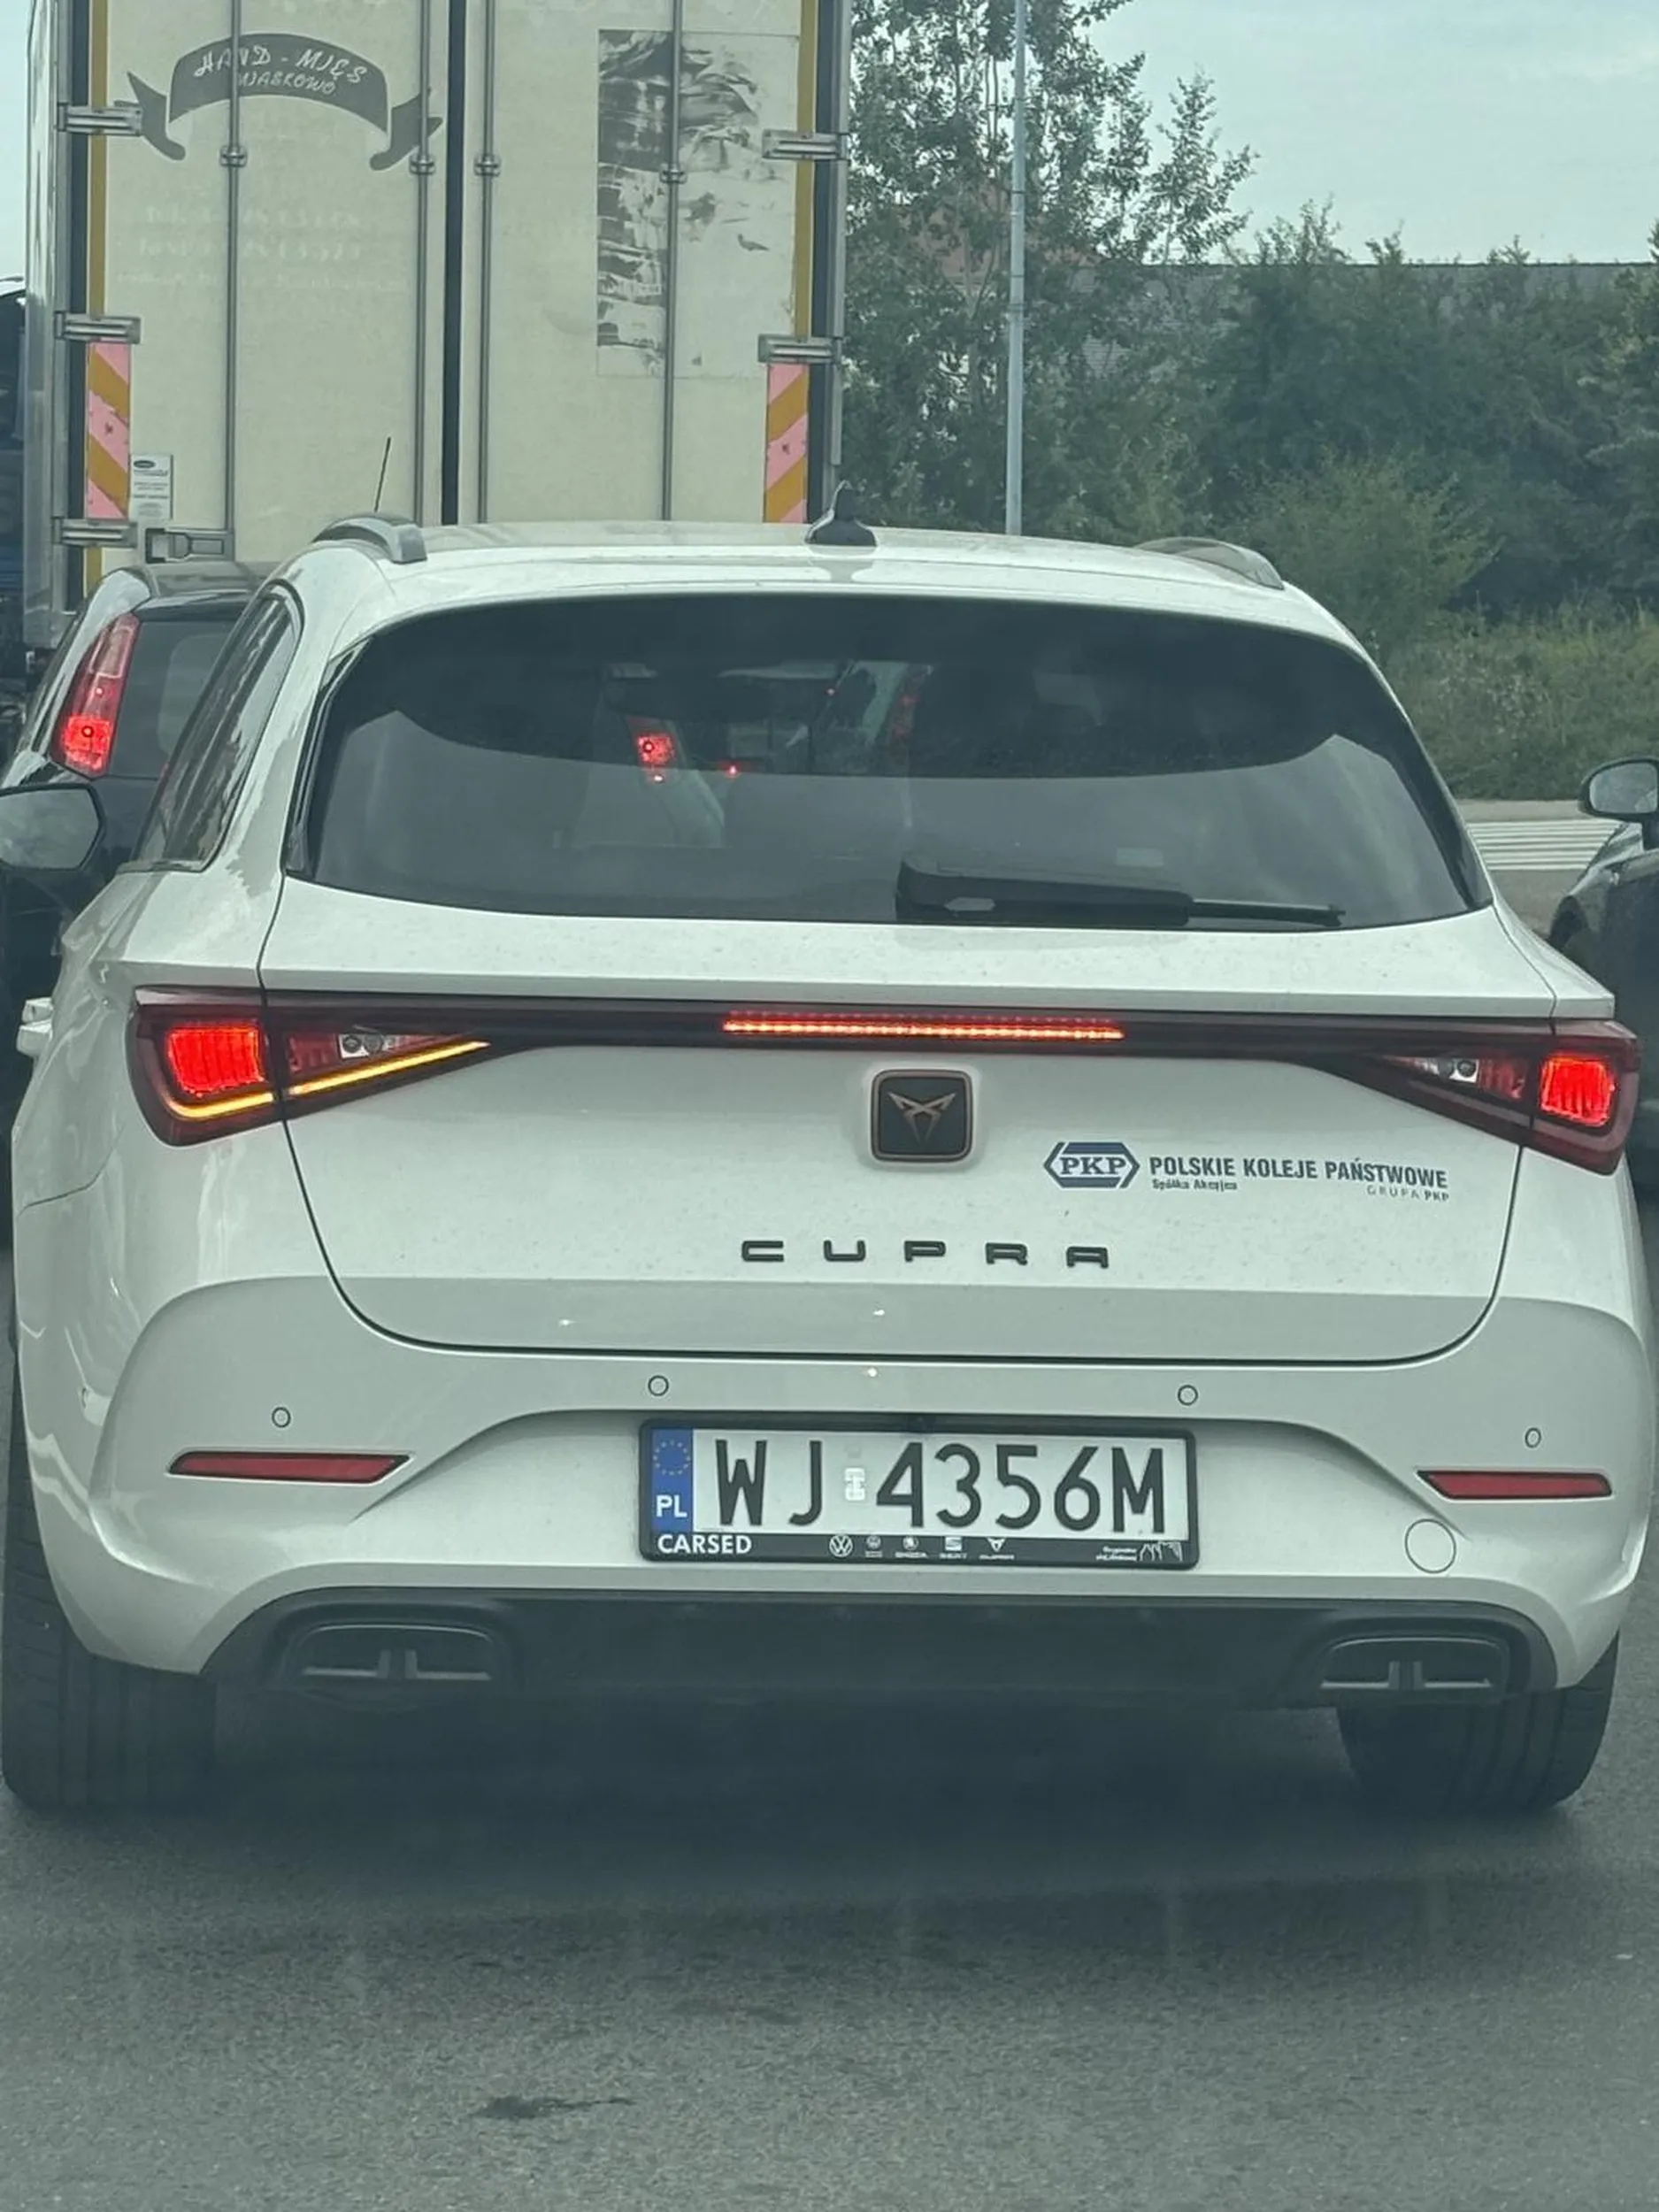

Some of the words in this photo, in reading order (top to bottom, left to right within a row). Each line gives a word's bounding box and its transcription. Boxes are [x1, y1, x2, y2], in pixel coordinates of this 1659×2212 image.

[1059, 1156, 1127, 1175] PKP
[1149, 1156, 1236, 1177] POLSKIE
[1242, 1157, 1318, 1179] KOLEJE
[1325, 1156, 1448, 1189] PAŃSTWOWE
[1424, 1189, 1450, 1202] PKP
[741, 1240, 1109, 1269] CUPRA
[715, 1439, 823, 1526] WJ
[876, 1441, 1164, 1534] 4356M
[656, 1494, 688, 1518] PL
[657, 1533, 752, 1555] CARSED
